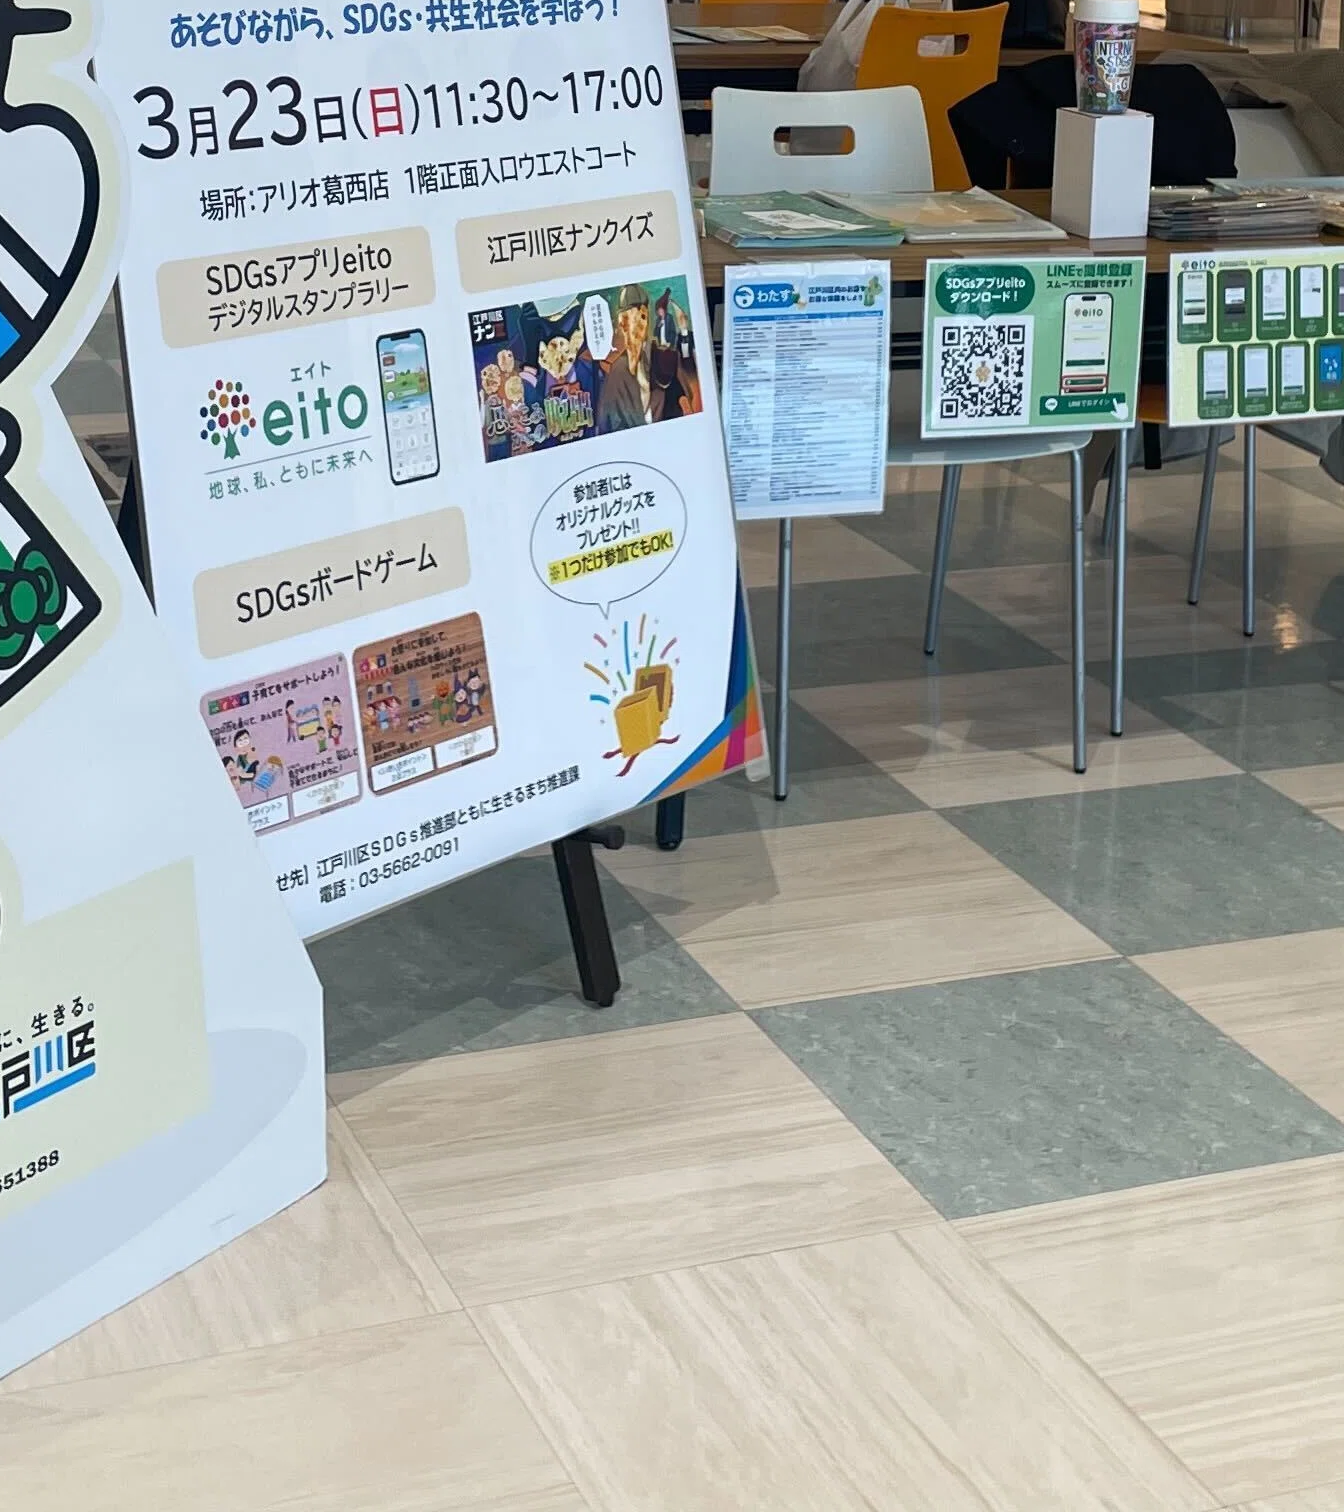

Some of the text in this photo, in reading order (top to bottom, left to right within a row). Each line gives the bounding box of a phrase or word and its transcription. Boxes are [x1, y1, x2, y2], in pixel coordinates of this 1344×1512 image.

[404, 140, 637, 195] 1階正面入口ウエストコート
[487, 211, 655, 266] 江戸川区ナンクイズ
[205, 243, 392, 296] SDGsアプリeito
[946, 277, 1026, 290] SDGsアプリeito
[1046, 263, 1133, 278] LINEで簡単登録
[207, 278, 410, 332] デジタルスタンプラリー
[757, 289, 791, 303] わたす
[290, 361, 331, 382] エイト
[263, 385, 368, 446] eito
[209, 449, 373, 500] 地球、私、ともに未来へ
[573, 473, 632, 503] 参加者には
[556, 491, 655, 531] オリジナルグッズを
[236, 542, 439, 624] SDGsボードゲーム
